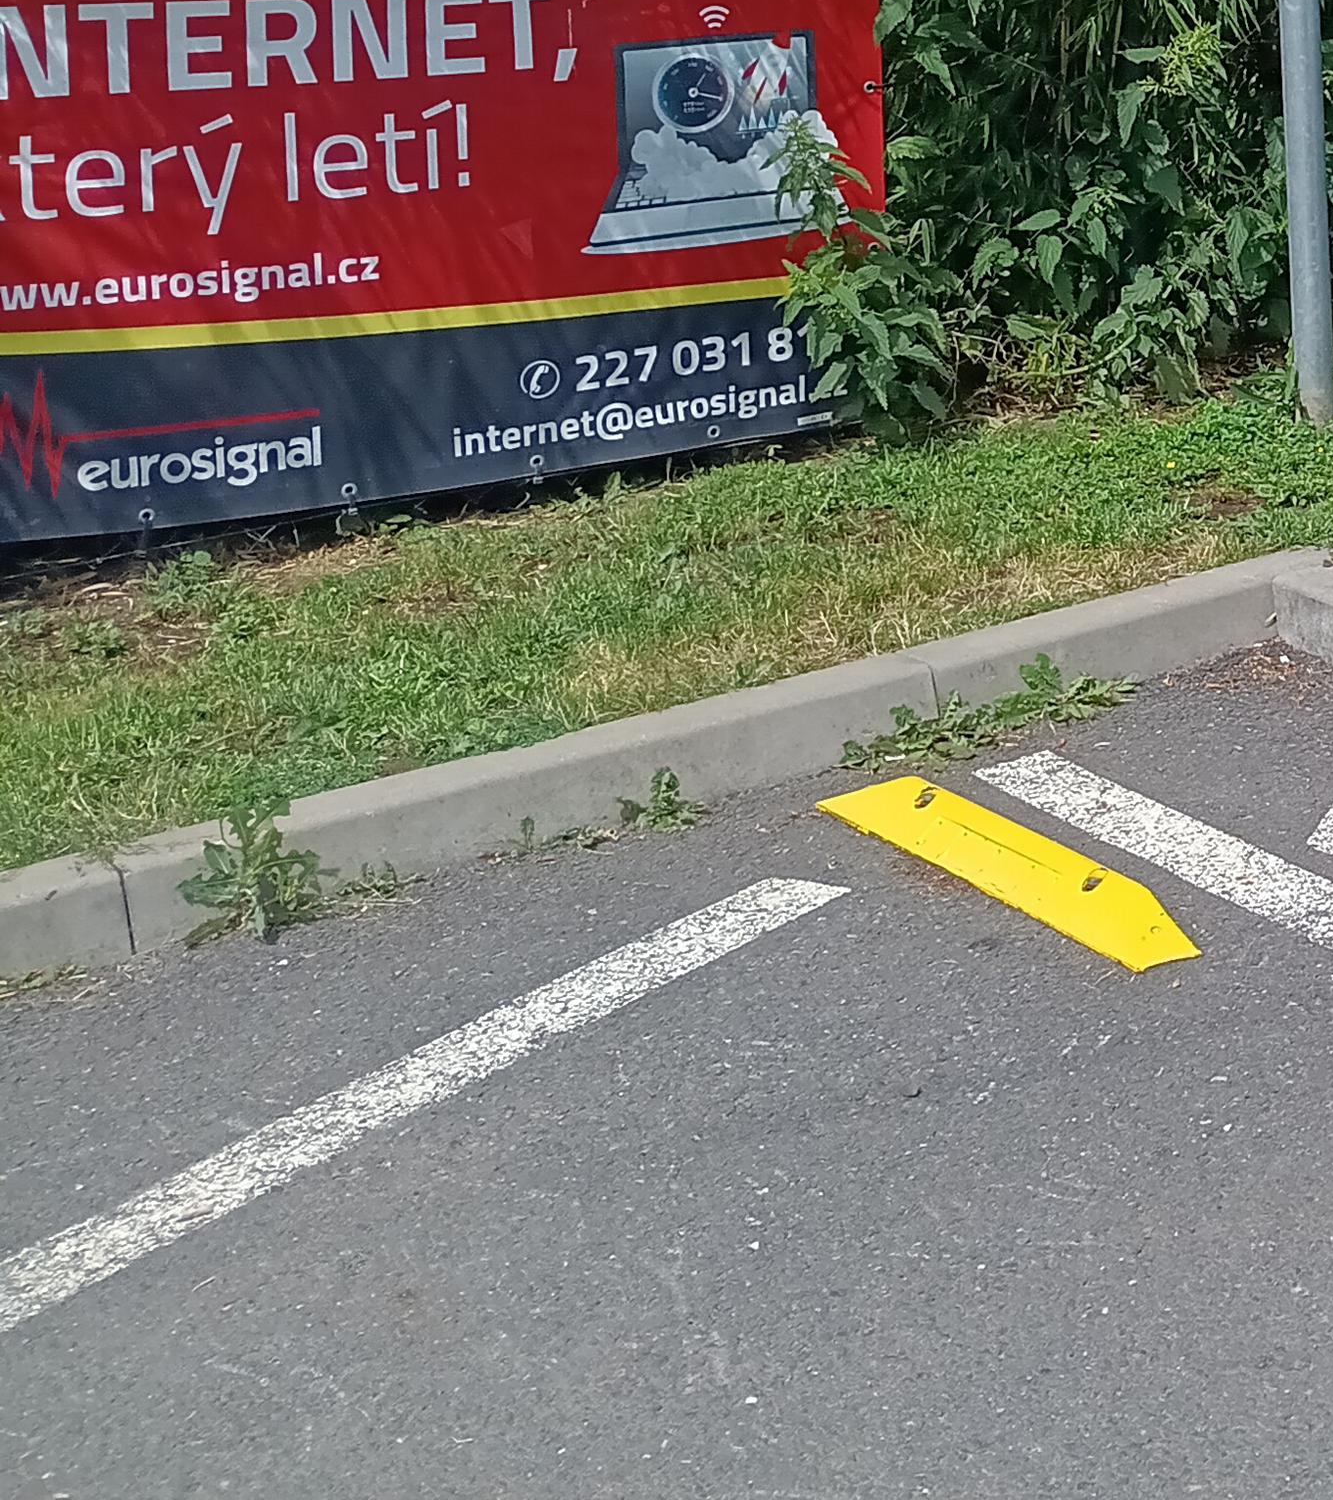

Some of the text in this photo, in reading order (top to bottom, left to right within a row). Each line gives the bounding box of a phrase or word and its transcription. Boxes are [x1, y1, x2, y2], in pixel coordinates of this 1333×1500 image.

[0, 100, 470, 235] terý letí!
[575, 346, 658, 392] 227
[672, 332, 751, 377] 031
[77, 426, 322, 492] eurosignal
